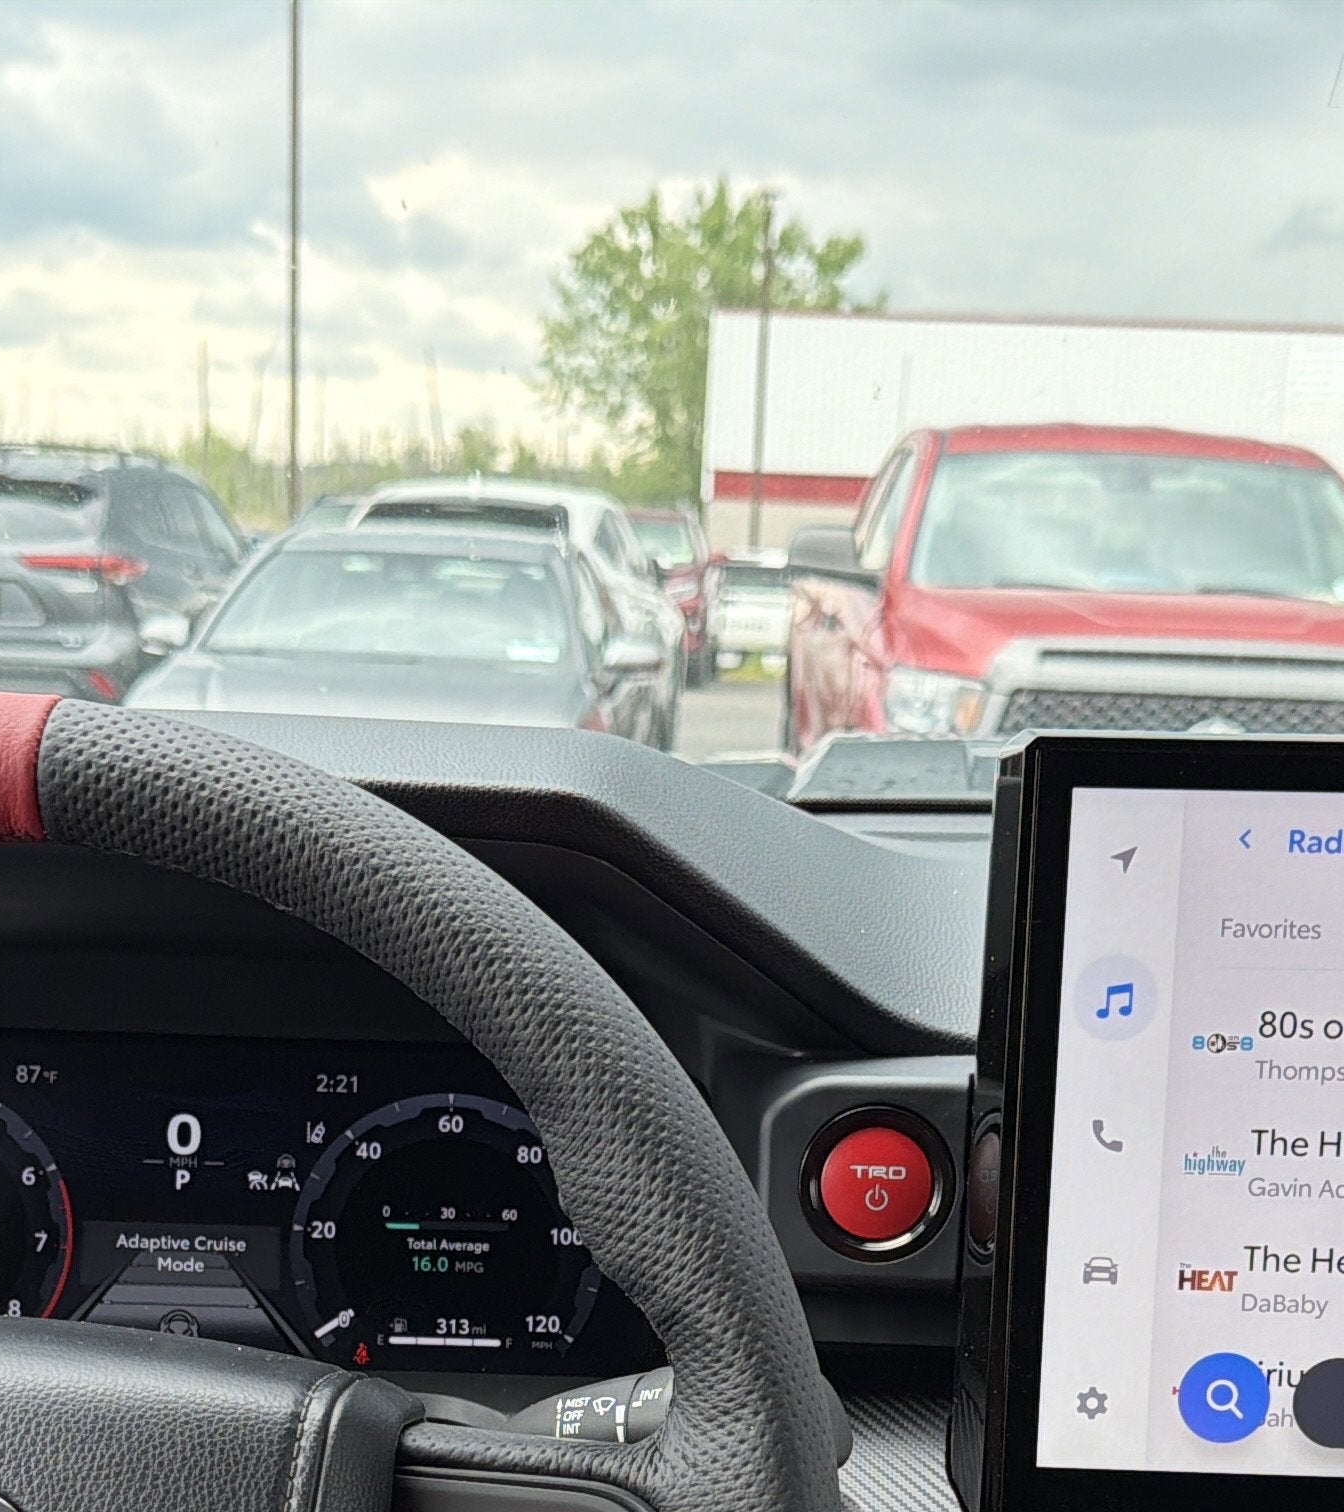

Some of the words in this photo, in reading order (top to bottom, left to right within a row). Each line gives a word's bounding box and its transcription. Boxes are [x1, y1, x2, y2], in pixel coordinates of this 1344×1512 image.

[1219, 917, 1322, 941] Favorites
[1258, 1010, 1315, 1039] 80s
[316, 1074, 359, 1094] 2:21
[438, 1115, 464, 1134] 60
[167, 1113, 202, 1156] 0
[1250, 1128, 1309, 1157] The
[356, 1142, 382, 1160] 40
[516, 1145, 542, 1165] 80
[849, 1164, 907, 1181] TRD
[1184, 1152, 1246, 1177] highway
[21, 1166, 36, 1185] 6
[175, 1170, 191, 1190] P
[1248, 1177, 1312, 1198] Gavin
[382, 1206, 391, 1218] 0
[440, 1207, 456, 1220] 30
[502, 1208, 518, 1222] 60
[310, 1221, 336, 1239] 20
[549, 1228, 584, 1247] 100
[34, 1232, 48, 1252] 7
[116, 1233, 190, 1253] Adaptive
[194, 1236, 247, 1252] Cruise
[407, 1238, 437, 1251] Total
[439, 1239, 490, 1255] Average
[157, 1256, 205, 1273] Mode
[411, 1256, 449, 1273] 16.0
[455, 1260, 484, 1274] MPG
[1243, 1245, 1302, 1274] The
[1178, 1269, 1238, 1292] HEAT
[7, 1300, 21, 1317] 8
[1240, 1293, 1329, 1320] DaBaby
[435, 1317, 470, 1336] 313
[525, 1315, 561, 1334] 120
[564, 1396, 591, 1408] MIST
[639, 1388, 663, 1402] INT
[563, 1410, 584, 1422] OFF
[563, 1423, 581, 1435] INT
